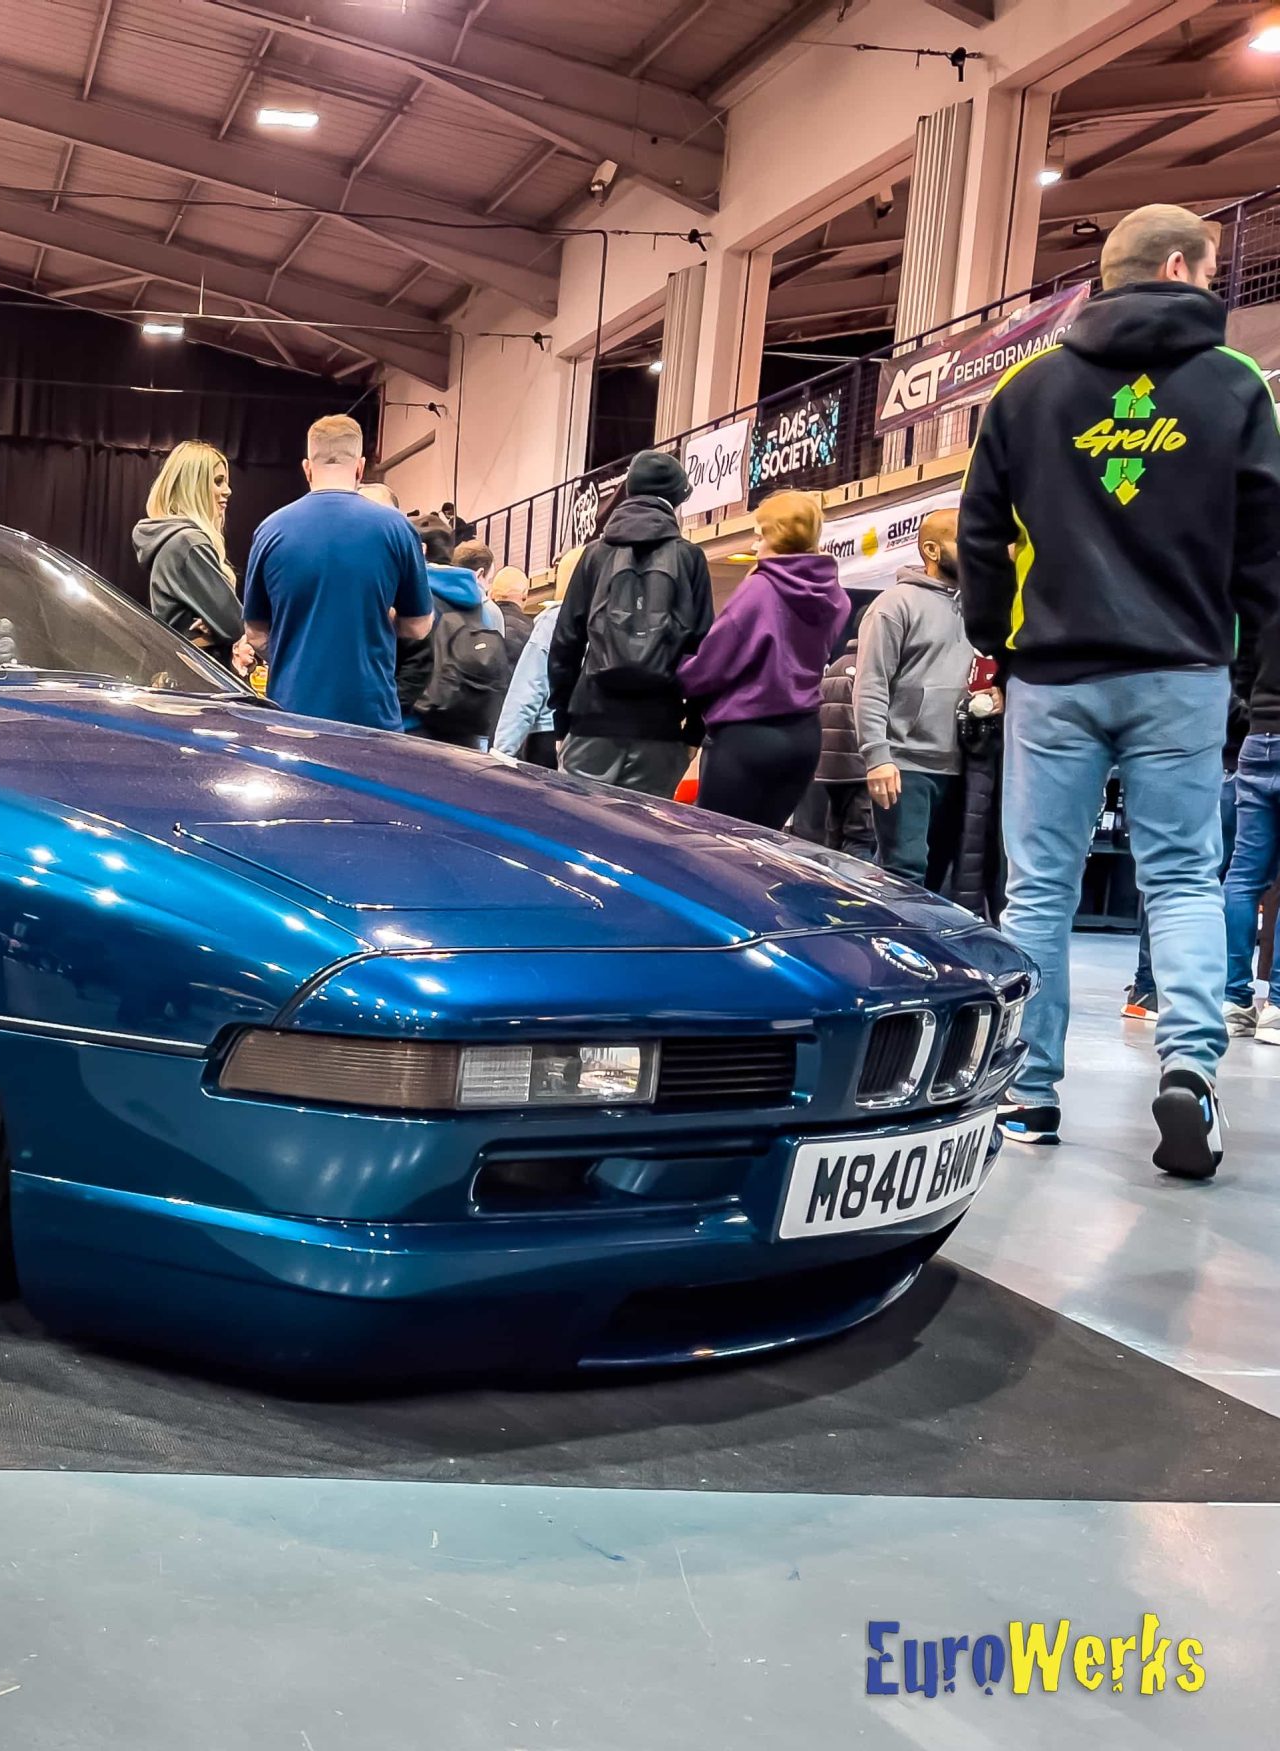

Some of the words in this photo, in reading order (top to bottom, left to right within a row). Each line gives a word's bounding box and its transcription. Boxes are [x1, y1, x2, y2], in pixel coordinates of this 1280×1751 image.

[880, 351, 960, 420] AGT
[954, 325, 1071, 384] PERFORMANC
[761, 434, 821, 480] SOCIETY
[1072, 418, 1187, 457] Grello
[805, 1145, 927, 1223] M840
[926, 1125, 985, 1203] BMW
